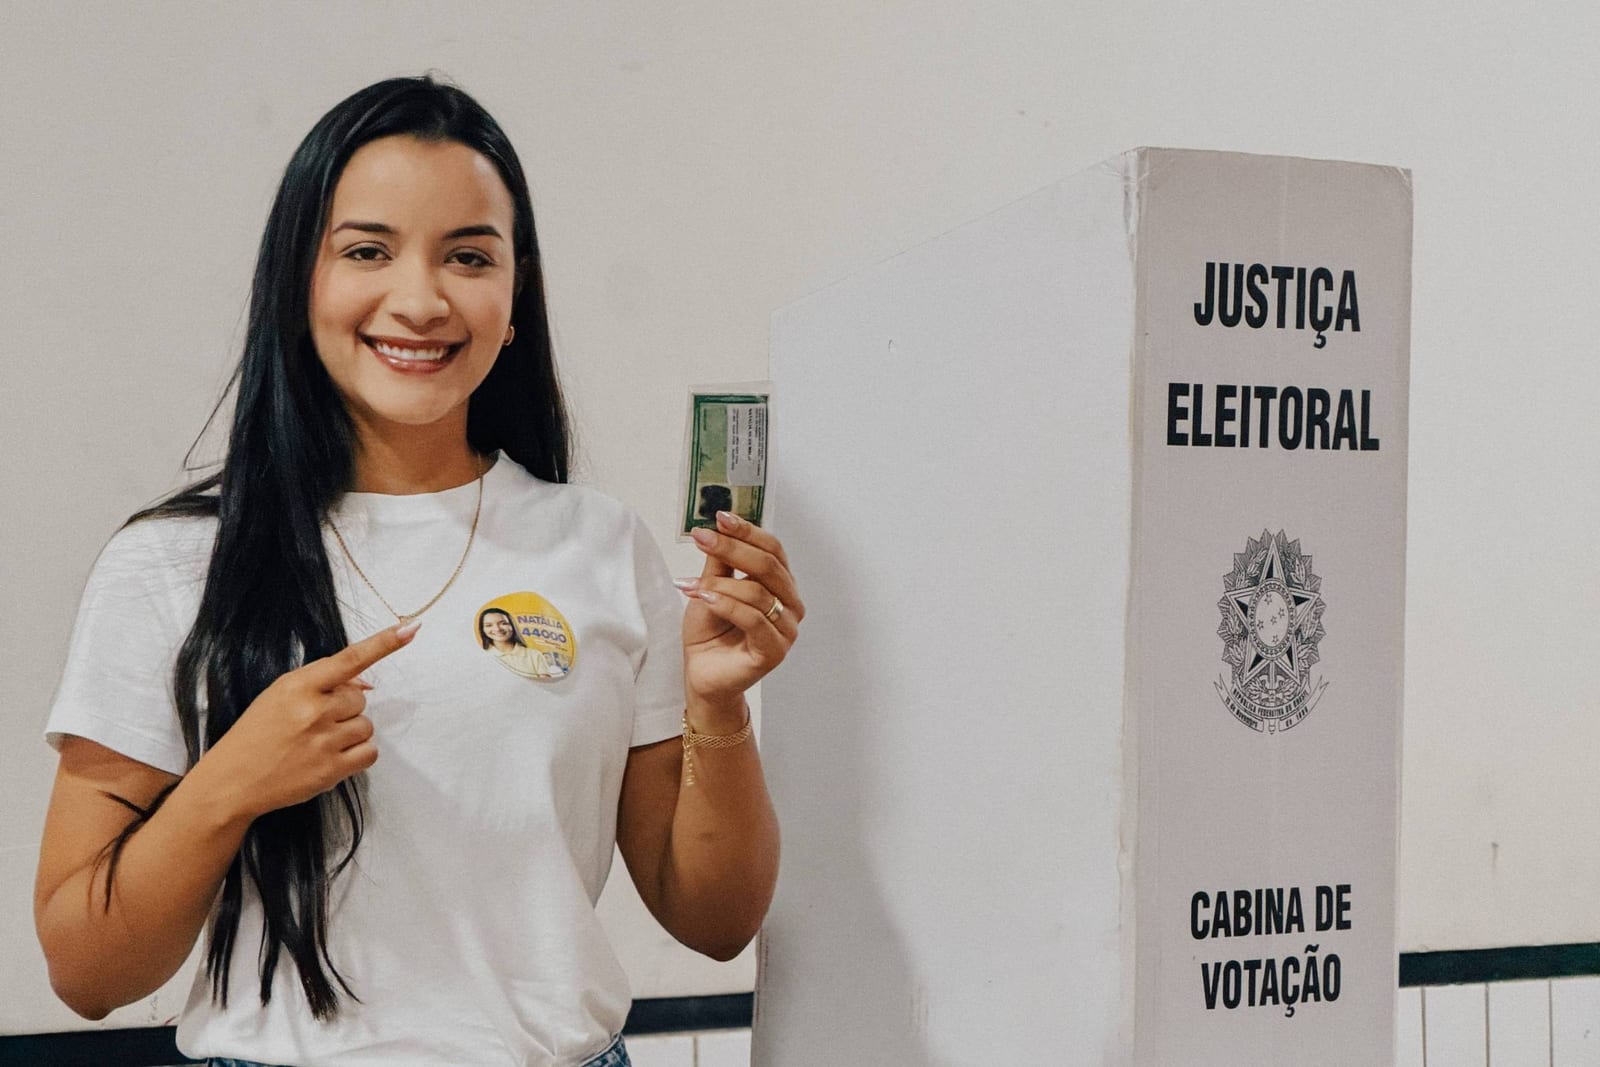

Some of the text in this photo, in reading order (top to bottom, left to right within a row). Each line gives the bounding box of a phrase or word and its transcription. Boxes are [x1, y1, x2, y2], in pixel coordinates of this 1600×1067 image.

[1193, 261, 1362, 350] JUSTIÇA
[1166, 382, 1381, 452] ELEITORAL
[522, 627, 567, 643] 44000
[1190, 883, 1352, 941] CABINA DE
[1200, 943, 1342, 1018] VOTAÇÃO
